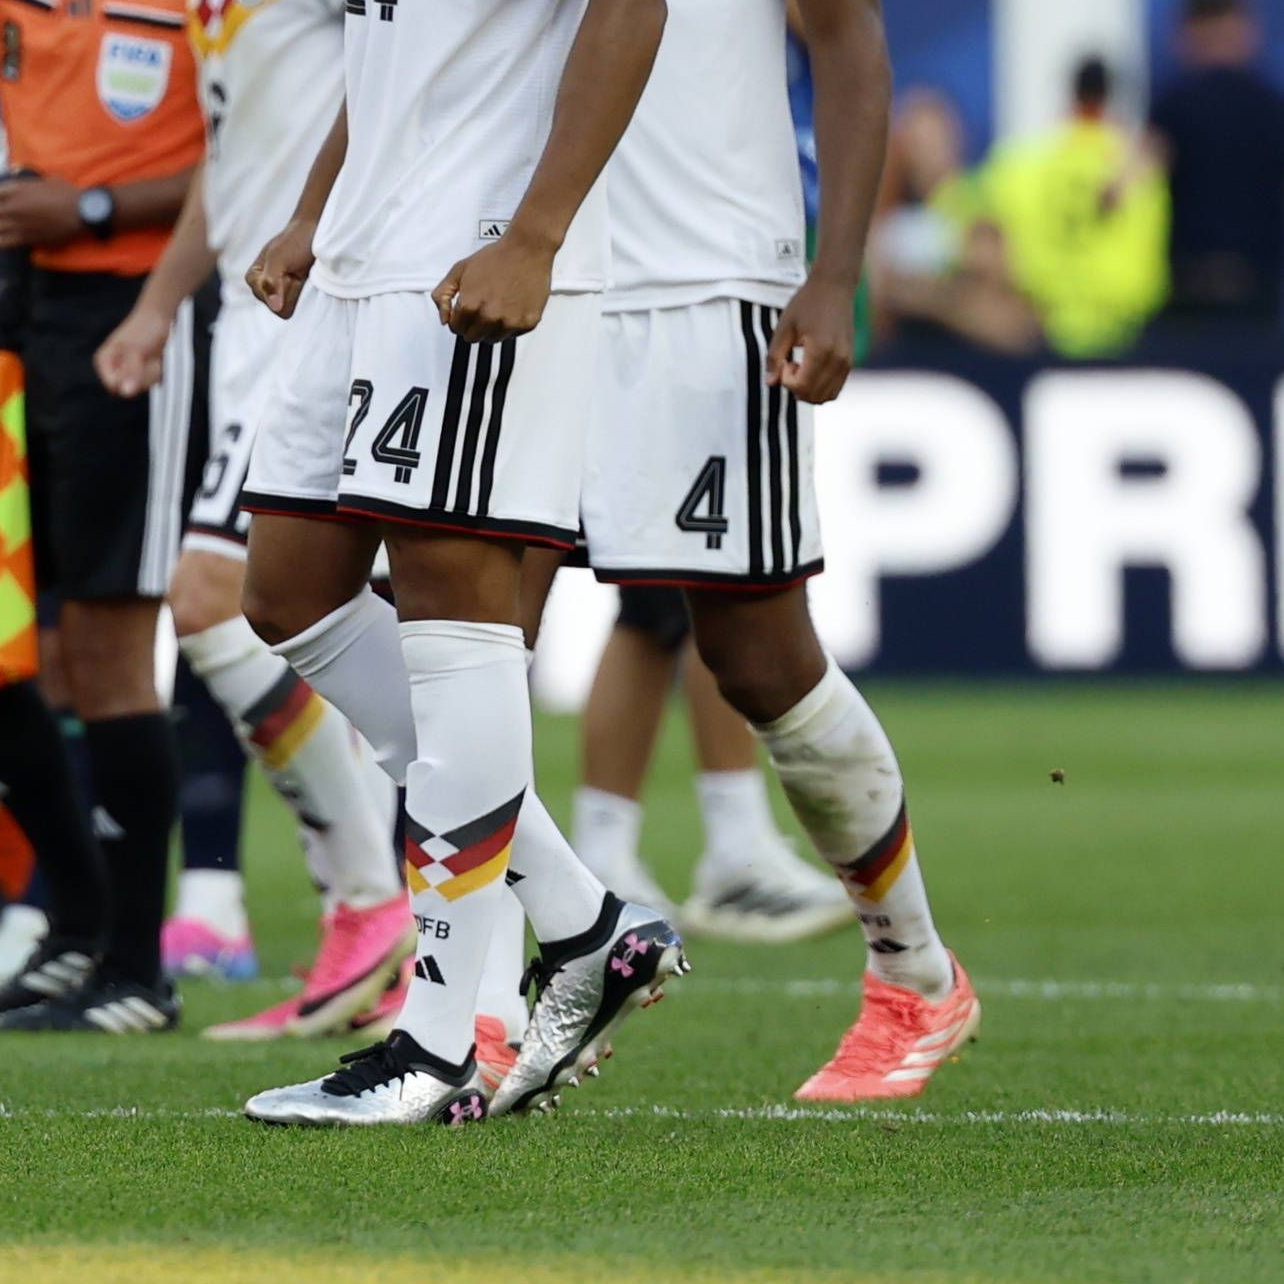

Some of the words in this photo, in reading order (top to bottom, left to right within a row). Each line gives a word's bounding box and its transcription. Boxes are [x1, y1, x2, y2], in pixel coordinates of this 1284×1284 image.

[342, 378, 430, 485] 24
[675, 455, 728, 550] 4
[811, 368, 1284, 671] PR
